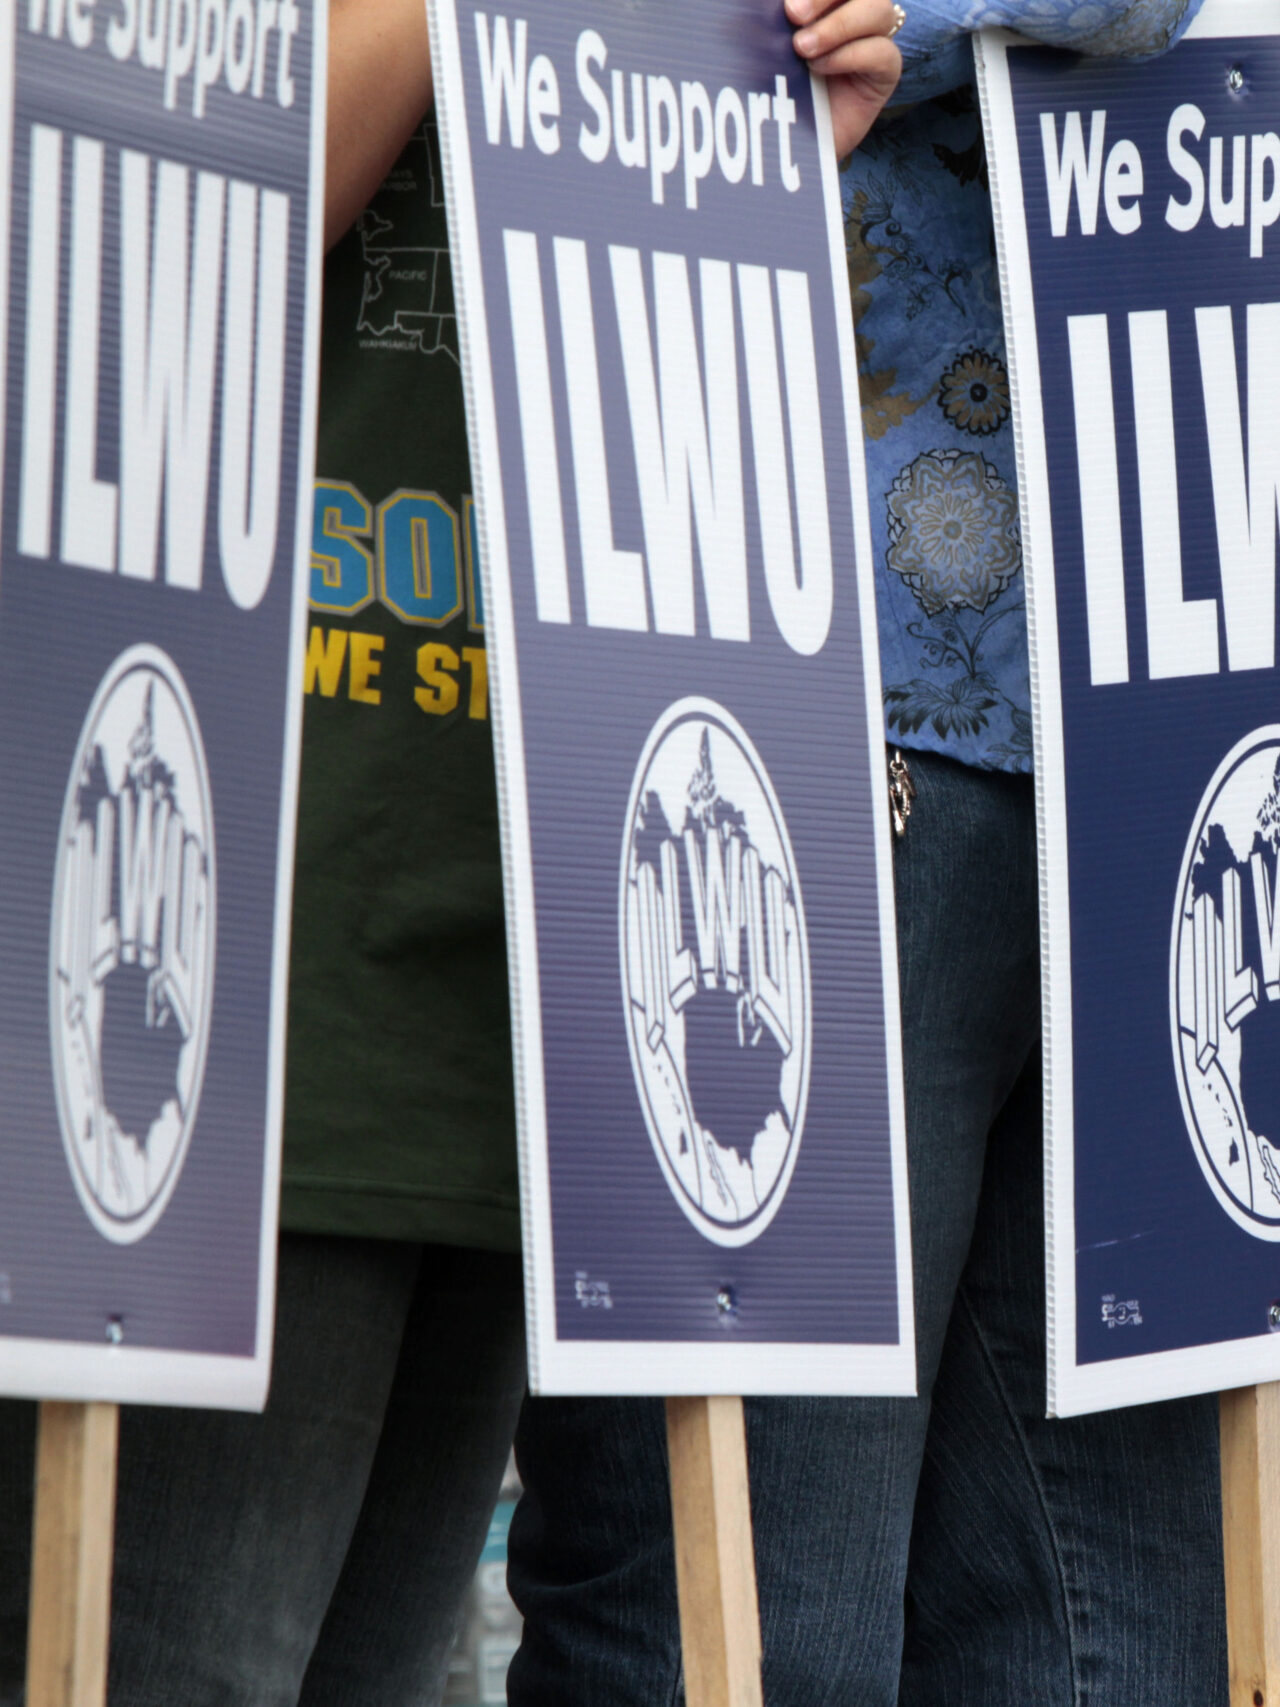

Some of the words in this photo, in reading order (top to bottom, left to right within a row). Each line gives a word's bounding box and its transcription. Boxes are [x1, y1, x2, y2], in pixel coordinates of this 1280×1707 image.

[474, 11, 561, 156] We
[575, 28, 801, 211] Support
[1039, 110, 1144, 238] We
[18, 123, 290, 611] ILWU
[502, 228, 834, 657] ILWU
[308, 476, 487, 633] SO
[303, 625, 386, 706] WE
[414, 641, 489, 721] ST
[636, 826, 794, 1060] ILWU
